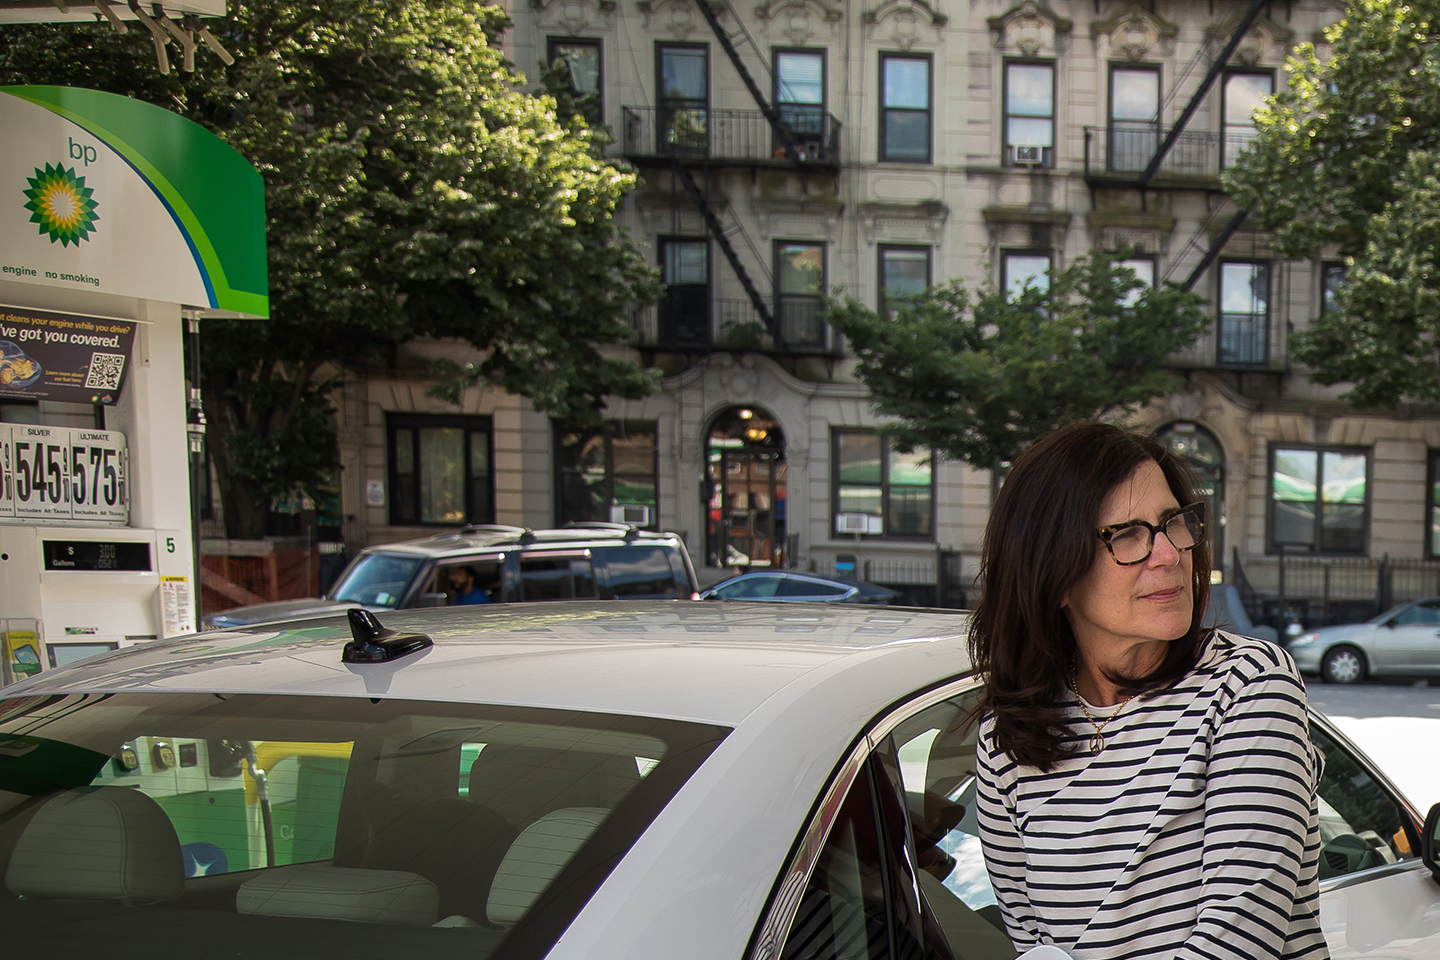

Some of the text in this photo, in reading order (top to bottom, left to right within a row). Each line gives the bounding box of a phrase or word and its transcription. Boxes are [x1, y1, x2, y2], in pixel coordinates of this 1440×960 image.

[69, 137, 97, 166] bp
[2, 265, 100, 286] engine no smoking
[6, 315, 30, 324] cleans
[31, 318, 48, 326] your
[49, 320, 73, 329] engine
[75, 322, 95, 331] while
[95, 325, 109, 333] you
[110, 325, 131, 334] drive?
[19, 328, 43, 342] got
[44, 331, 68, 344] you
[70, 334, 121, 348] covered.
[27, 428, 51, 437] SILVER
[80, 433, 110, 441] ULTIMATE
[68, 546, 75, 555] $
[166, 537, 175, 553] 5
